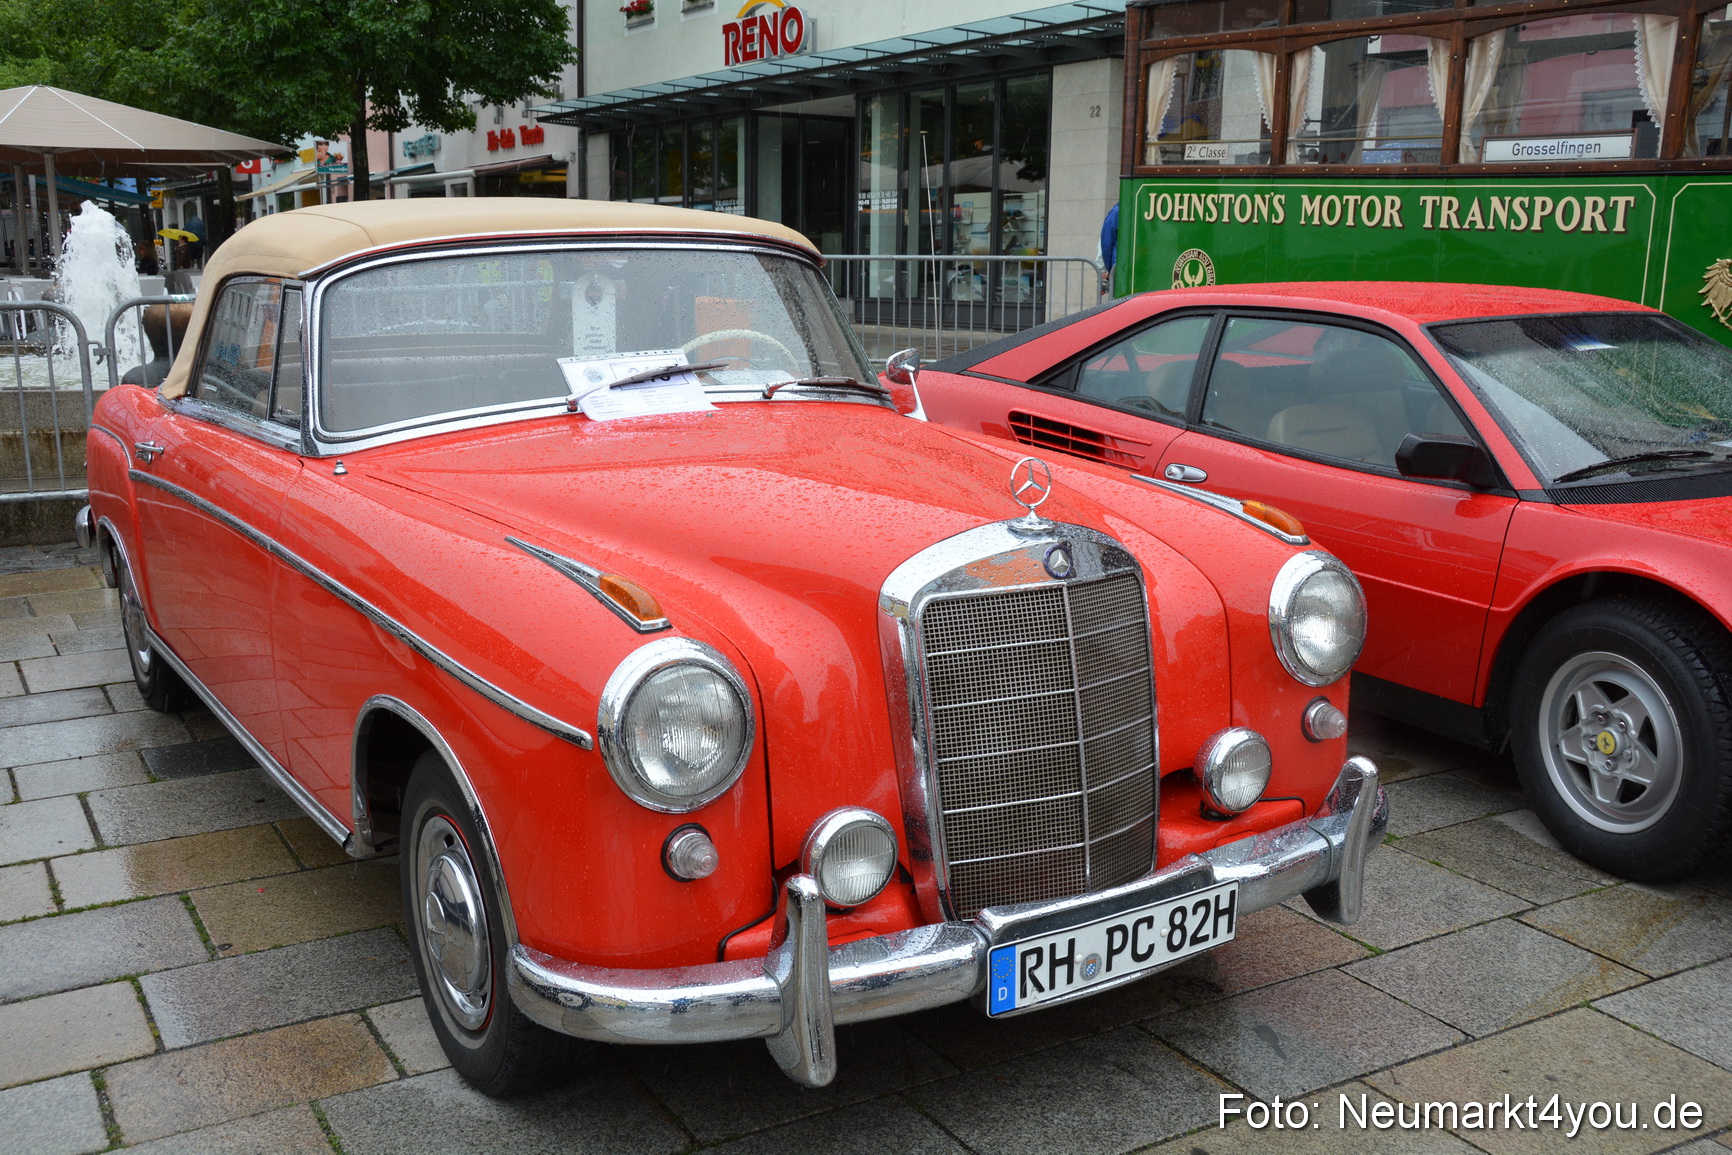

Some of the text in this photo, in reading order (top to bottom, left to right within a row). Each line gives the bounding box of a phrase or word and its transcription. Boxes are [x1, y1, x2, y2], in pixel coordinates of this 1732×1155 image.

[722, 6, 805, 66] RENO
[1089, 104, 1101, 119] 22
[1198, 146, 1227, 158] Classe
[1511, 140, 1602, 158] Grosselfingen
[1144, 191, 1636, 233] JOHNSTON'S MOTOR TRANSPORT
[998, 986, 1008, 1001] D
[1019, 937, 1076, 999] RH
[1105, 914, 1155, 973] PC
[1166, 889, 1237, 953] 82H
